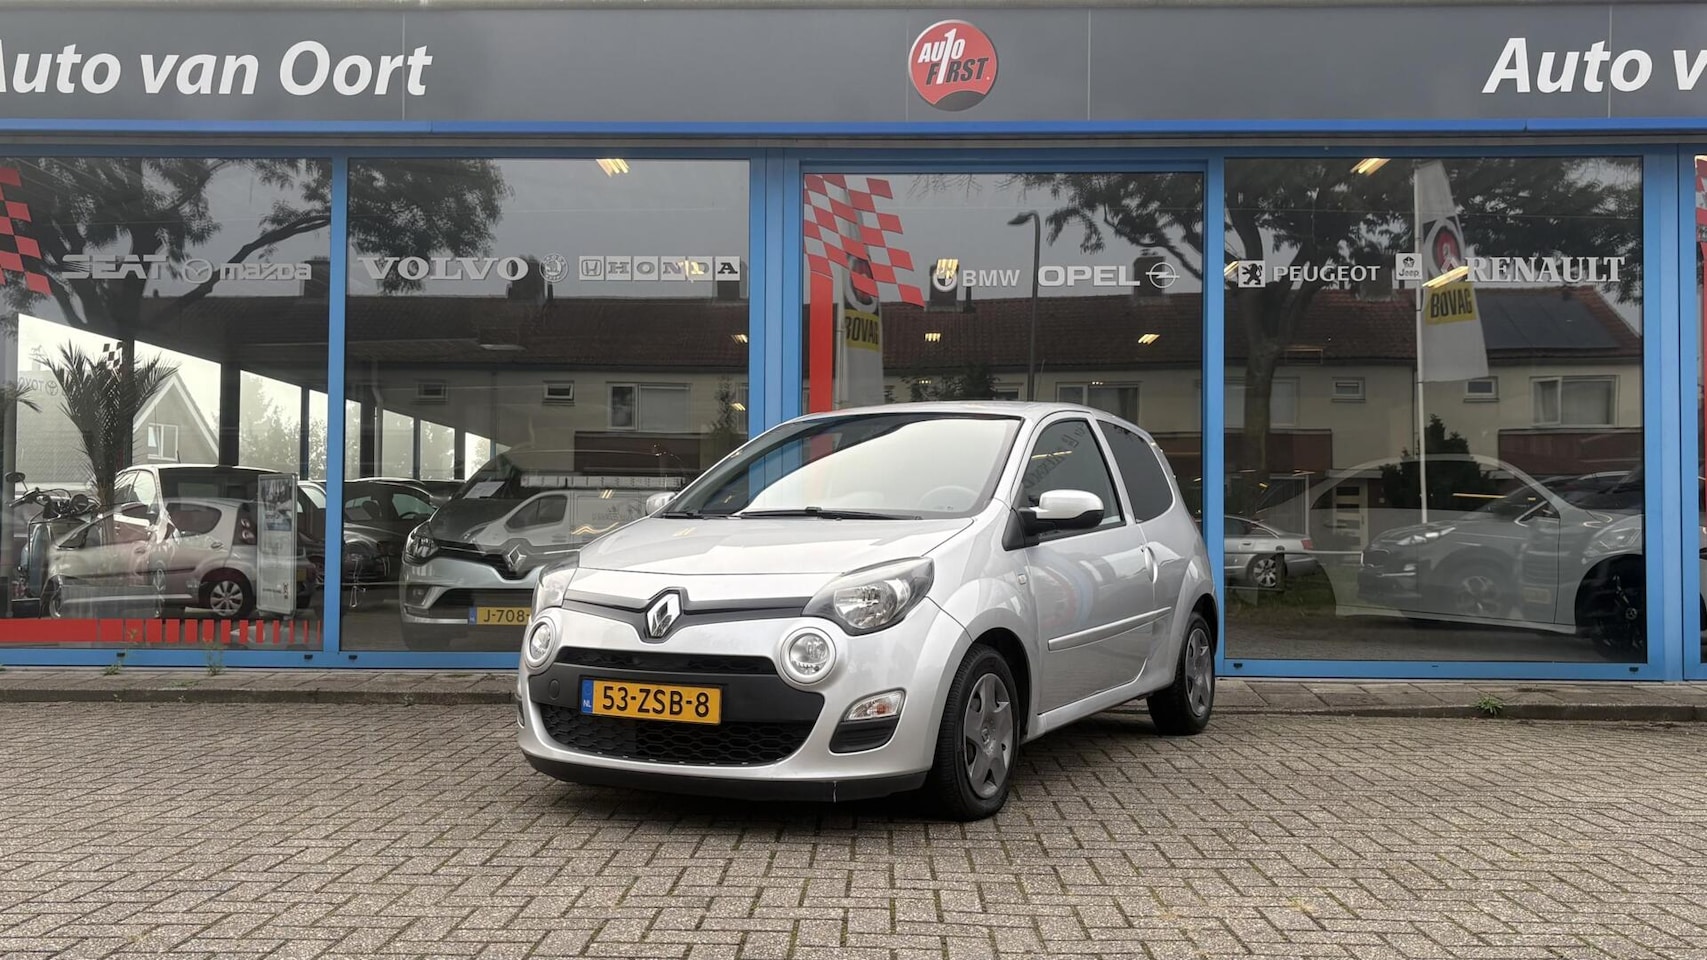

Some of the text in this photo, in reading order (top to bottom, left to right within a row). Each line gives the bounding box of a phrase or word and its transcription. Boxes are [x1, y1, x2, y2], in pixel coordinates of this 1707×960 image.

[0, 39, 433, 96] uto van Oort
[1482, 37, 1653, 93] Auto
[62, 254, 169, 280] SEAT
[357, 256, 529, 281] VOLVO
[607, 261, 738, 275] HONDA
[962, 269, 1021, 287] BMW
[1038, 265, 1141, 287] OPEL
[1273, 265, 1381, 282] PEUGEOT
[1399, 268, 1419, 278] Jeep
[1465, 256, 1626, 283] RENAULT
[1430, 288, 1473, 319] BOVAG
[583, 699, 592, 708] NL
[602, 686, 710, 718] 53-ZSB-8
